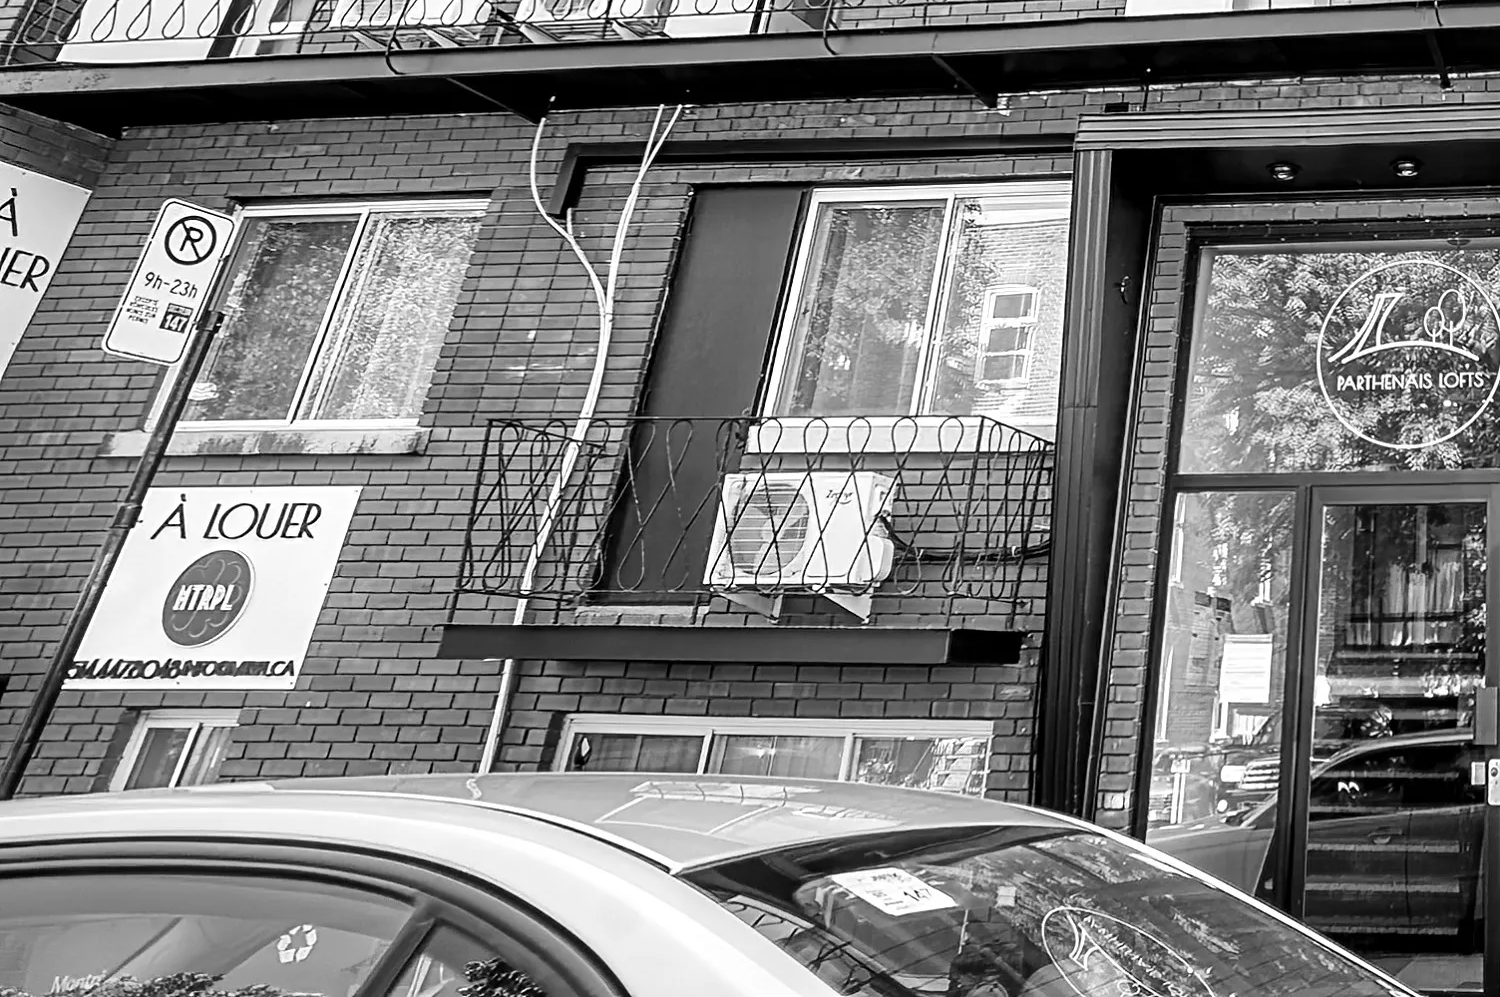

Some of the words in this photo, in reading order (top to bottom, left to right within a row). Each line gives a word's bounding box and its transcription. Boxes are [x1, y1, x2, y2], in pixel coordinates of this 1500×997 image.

[144, 271, 198, 299] 9h-23h
[164, 314, 188, 332] 147
[1336, 373, 1433, 391] PARTHENAIS
[1438, 372, 1485, 389] LOFTS
[150, 493, 187, 540] À
[203, 502, 322, 540] LOUER
